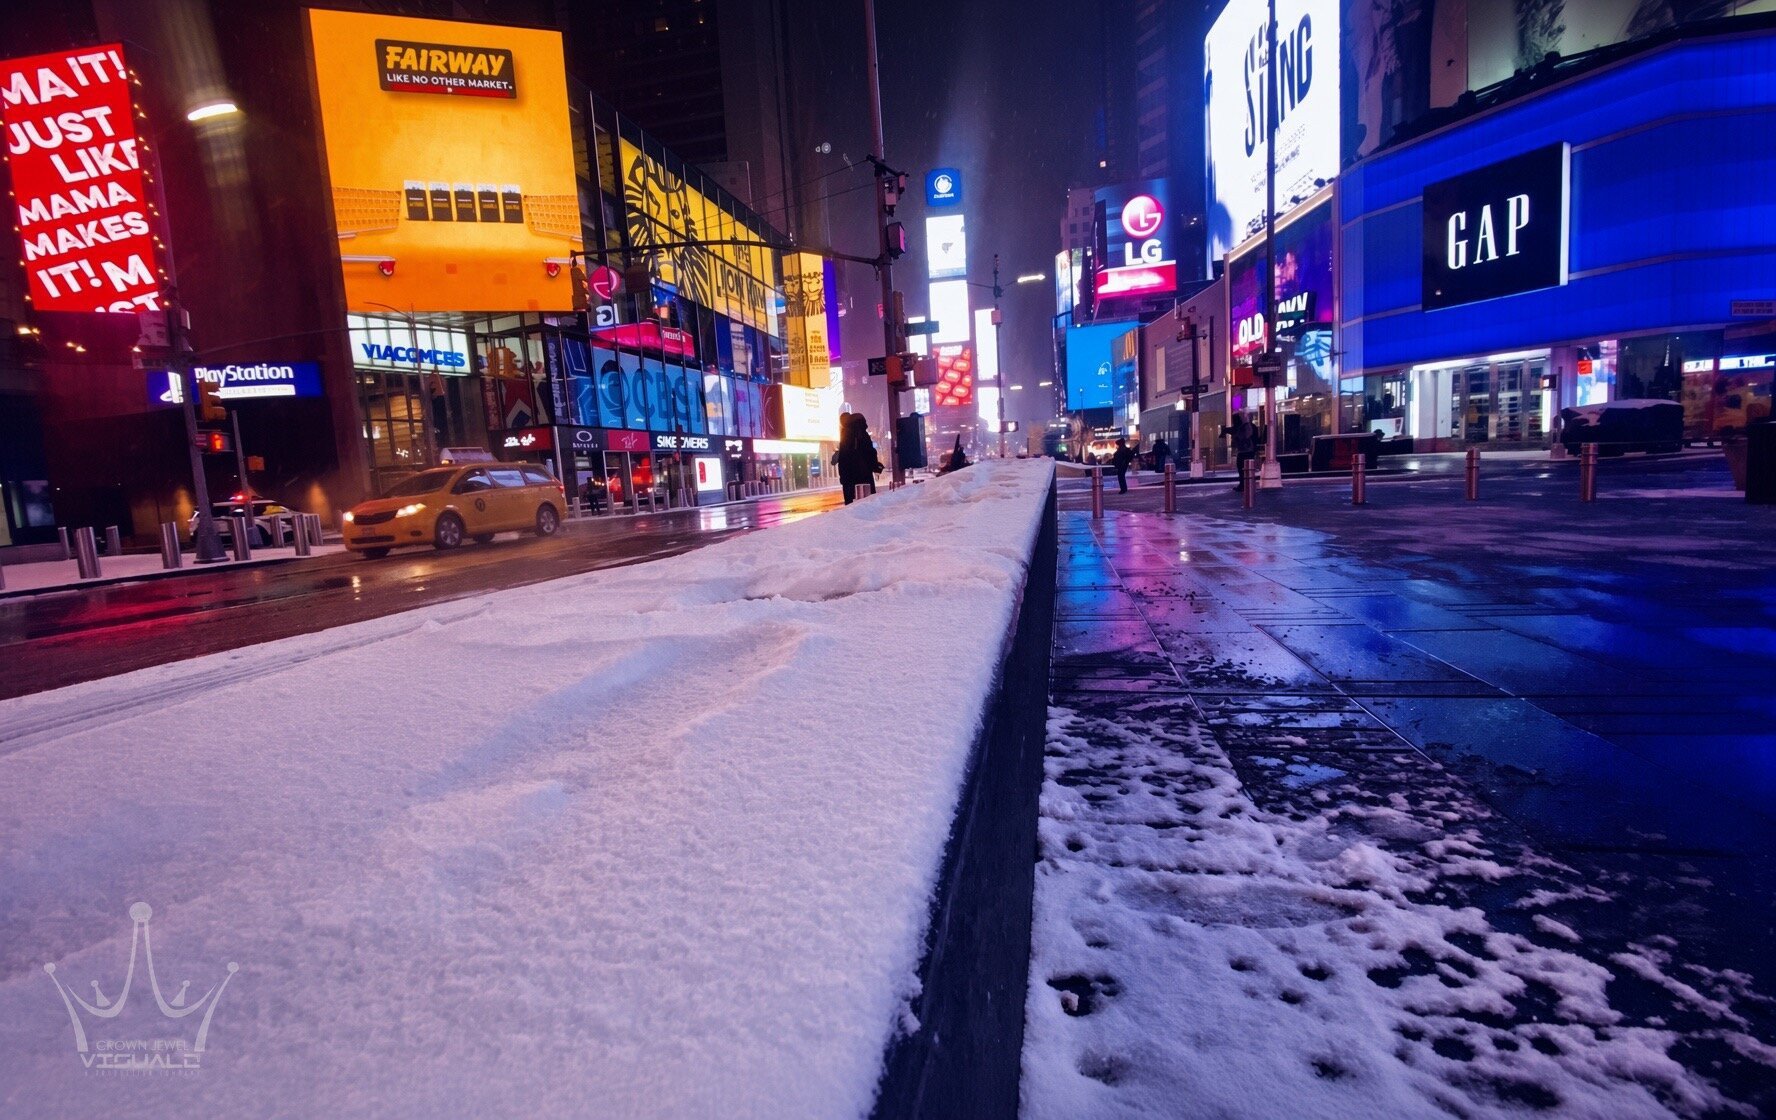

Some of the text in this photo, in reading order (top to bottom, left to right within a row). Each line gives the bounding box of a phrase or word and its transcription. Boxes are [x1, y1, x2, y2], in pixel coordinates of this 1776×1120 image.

[66, 50, 127, 87] IT!
[386, 46, 505, 76] FAIRWAY
[386, 73, 513, 90] LIKE NO OTHER MARKET.
[9, 105, 115, 155] JUST
[19, 181, 137, 226] MAMA
[24, 211, 149, 261] MAKES
[1447, 193, 1530, 270] GAP
[1125, 238, 1163, 266] LG
[36, 254, 156, 298] IT! M
[1239, 312, 1264, 345] OLD
[194, 363, 294, 388] PlayStation
